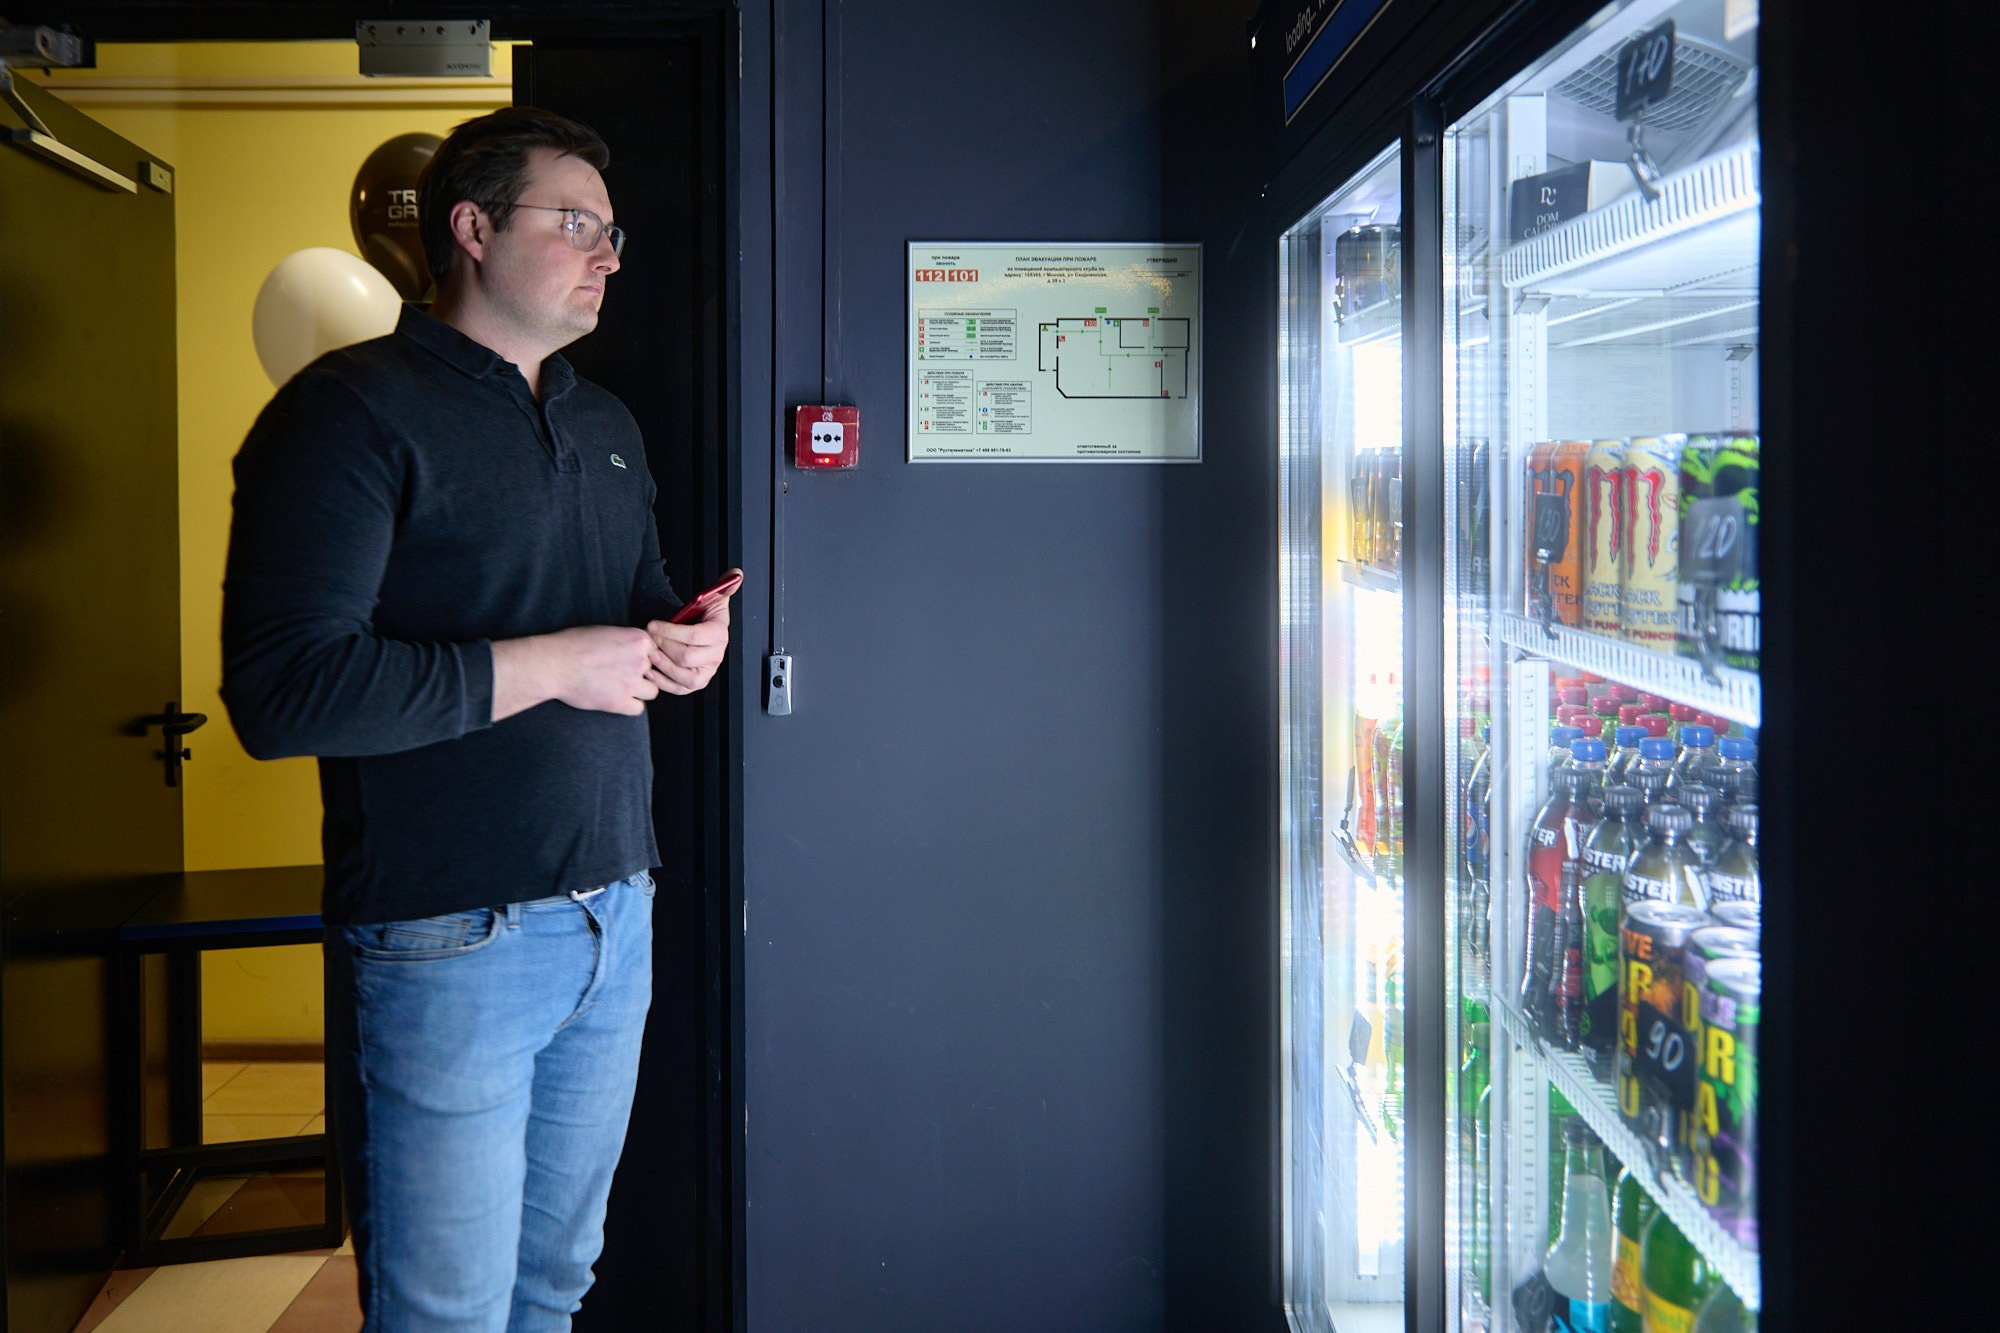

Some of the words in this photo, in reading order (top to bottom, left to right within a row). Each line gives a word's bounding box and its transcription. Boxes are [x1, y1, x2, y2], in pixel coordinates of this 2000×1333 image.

[1536, 211, 1559, 226] DOM
[917, 270, 943, 281] 112
[950, 270, 977, 281] 101
[1645, 1020, 1684, 1071] 90
